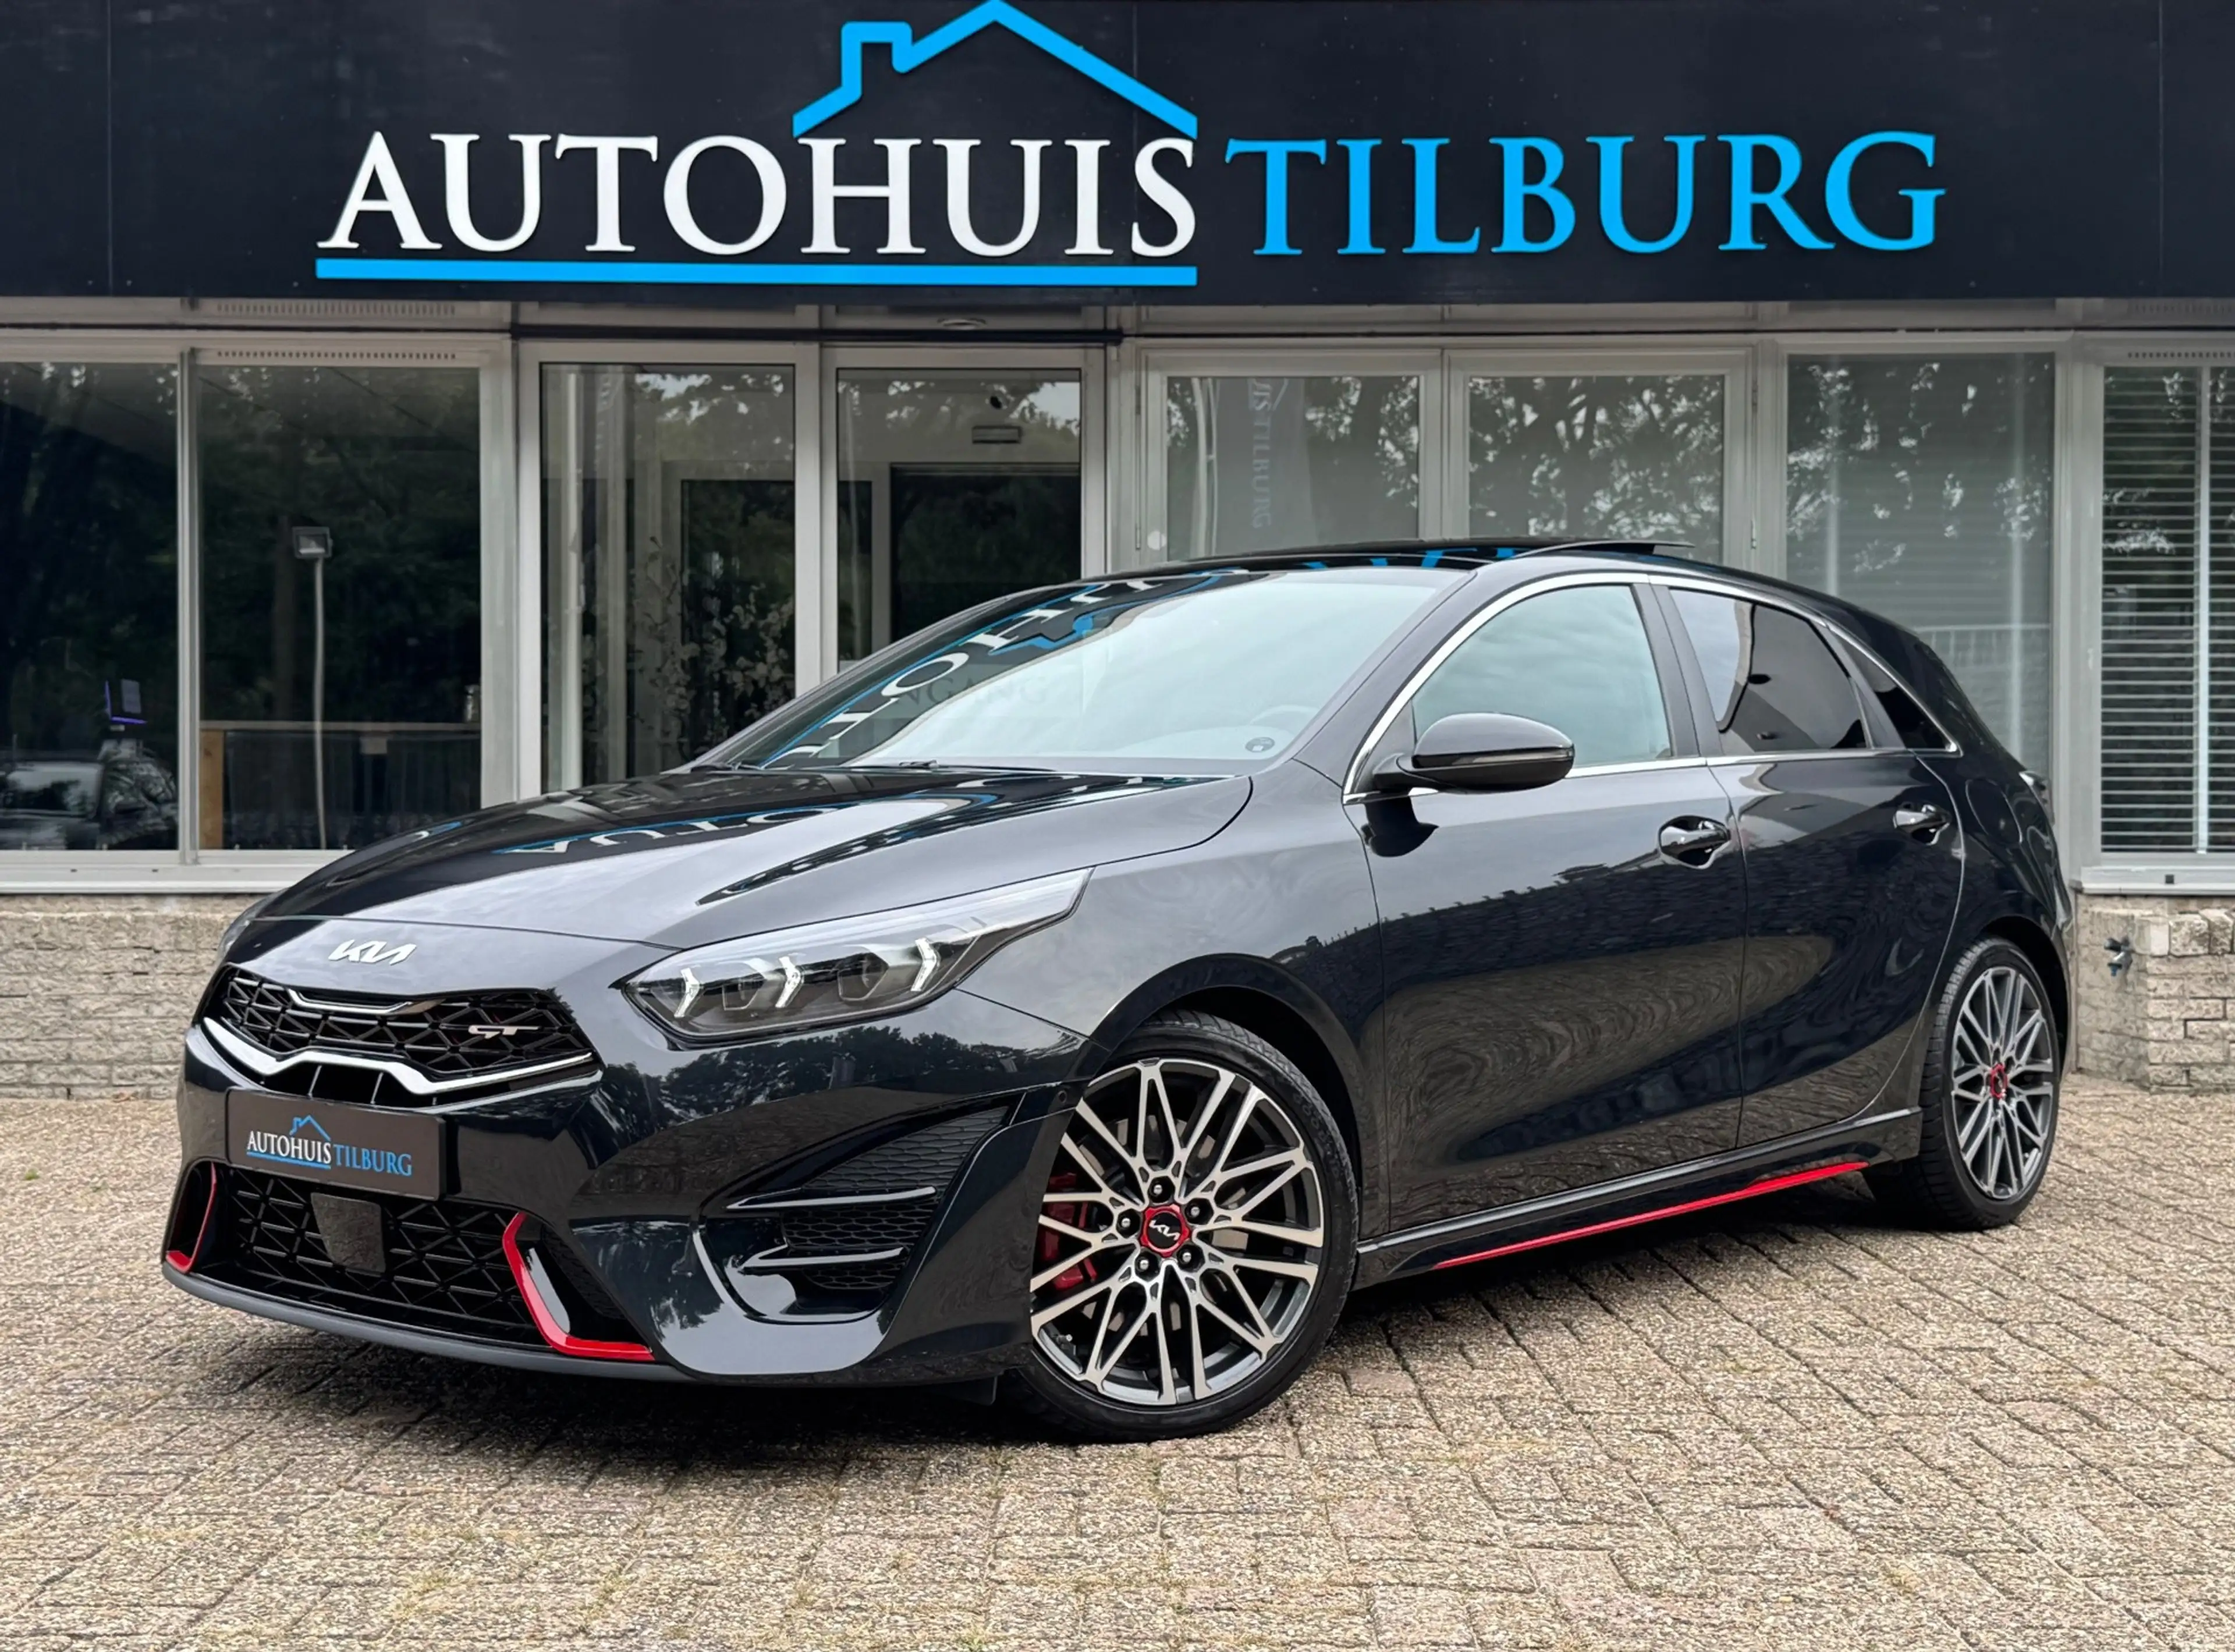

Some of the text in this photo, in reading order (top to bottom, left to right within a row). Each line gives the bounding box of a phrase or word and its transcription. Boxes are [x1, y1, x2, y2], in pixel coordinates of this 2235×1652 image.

[317, 131, 1946, 257] AUTOHUIS TILBURG
[328, 939, 417, 965] KIA
[468, 1025, 540, 1039] GT
[247, 1130, 413, 1177] AUTOHUIS TILBURG
